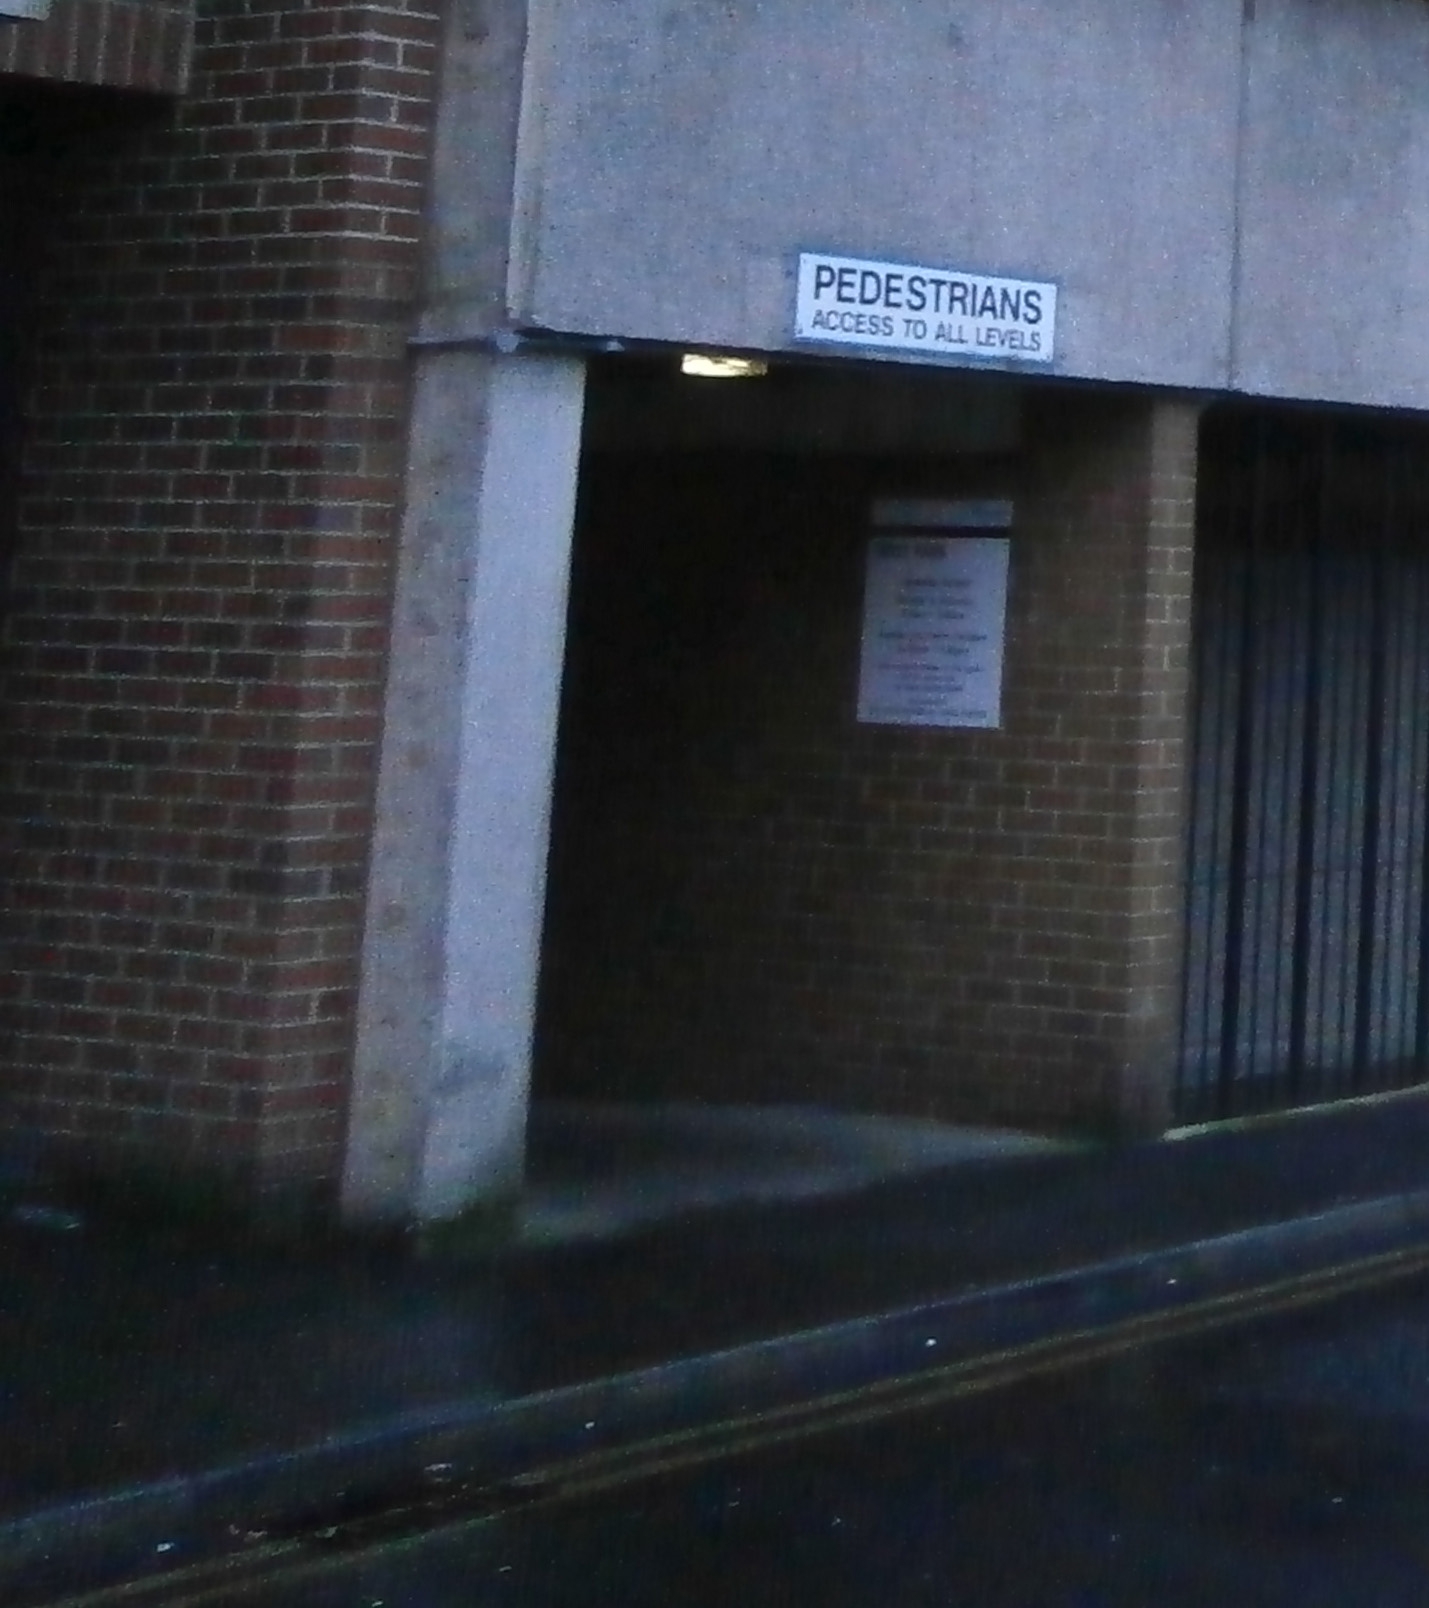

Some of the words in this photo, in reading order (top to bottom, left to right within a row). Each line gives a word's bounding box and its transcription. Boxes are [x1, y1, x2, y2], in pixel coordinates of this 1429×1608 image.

[813, 264, 1042, 324] PEDESTRIANS
[811, 309, 894, 337] ACCESS
[903, 318, 927, 340] TO
[934, 321, 968, 344] ALL
[976, 327, 1041, 351] LEVELS
